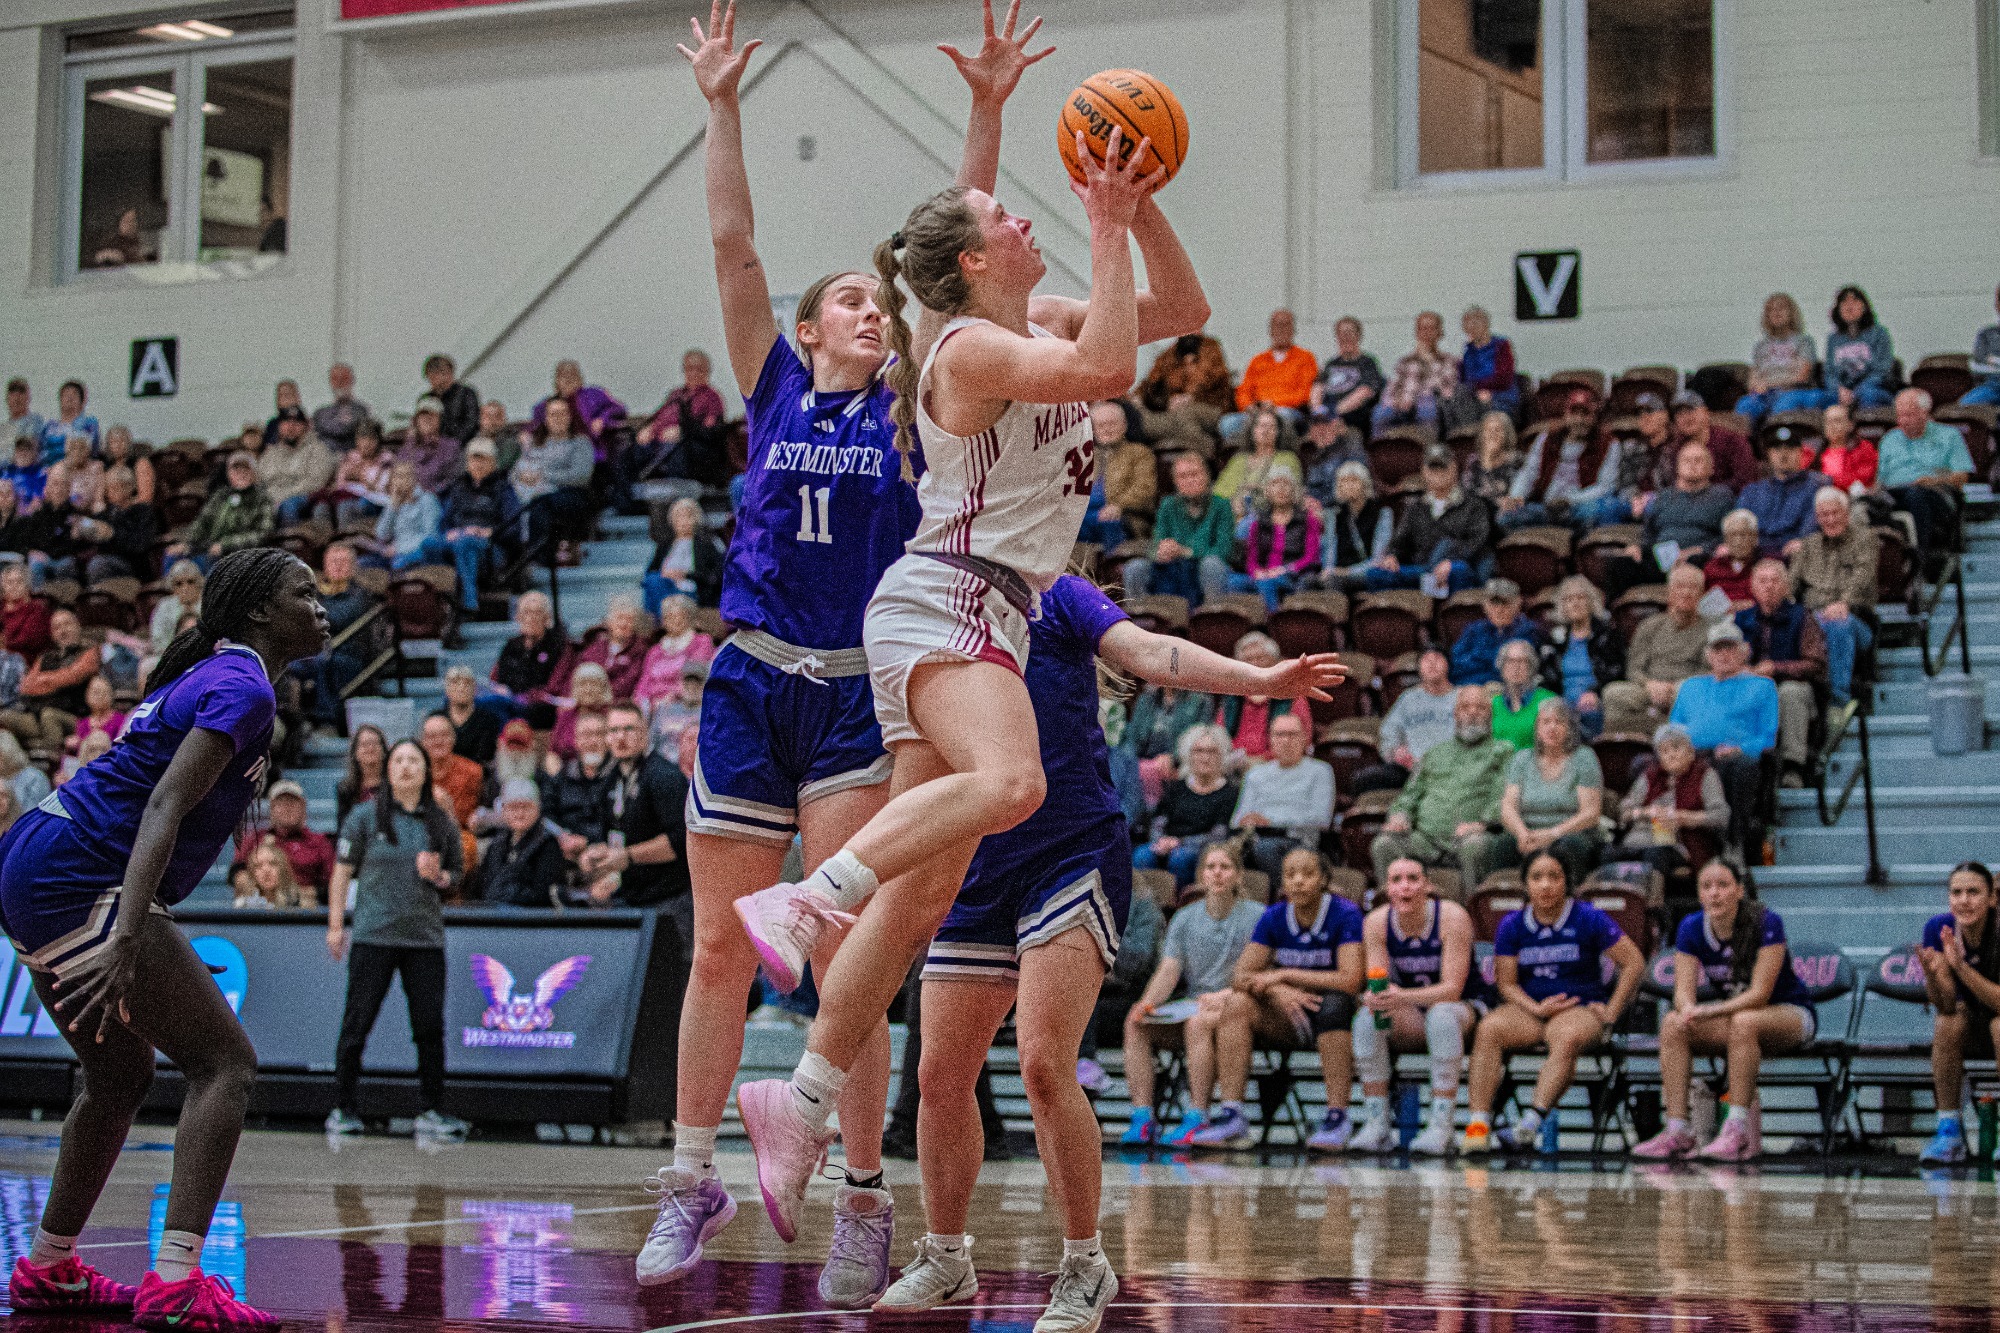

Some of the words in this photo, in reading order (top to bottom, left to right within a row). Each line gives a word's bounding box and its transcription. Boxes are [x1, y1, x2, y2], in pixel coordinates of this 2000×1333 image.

[1518, 254, 1577, 316] V
[133, 341, 176, 395] A
[764, 441, 884, 478] WESTMINSTER
[1063, 440, 1094, 497] 32
[796, 484, 833, 544] 11
[1793, 955, 1841, 988] MU
